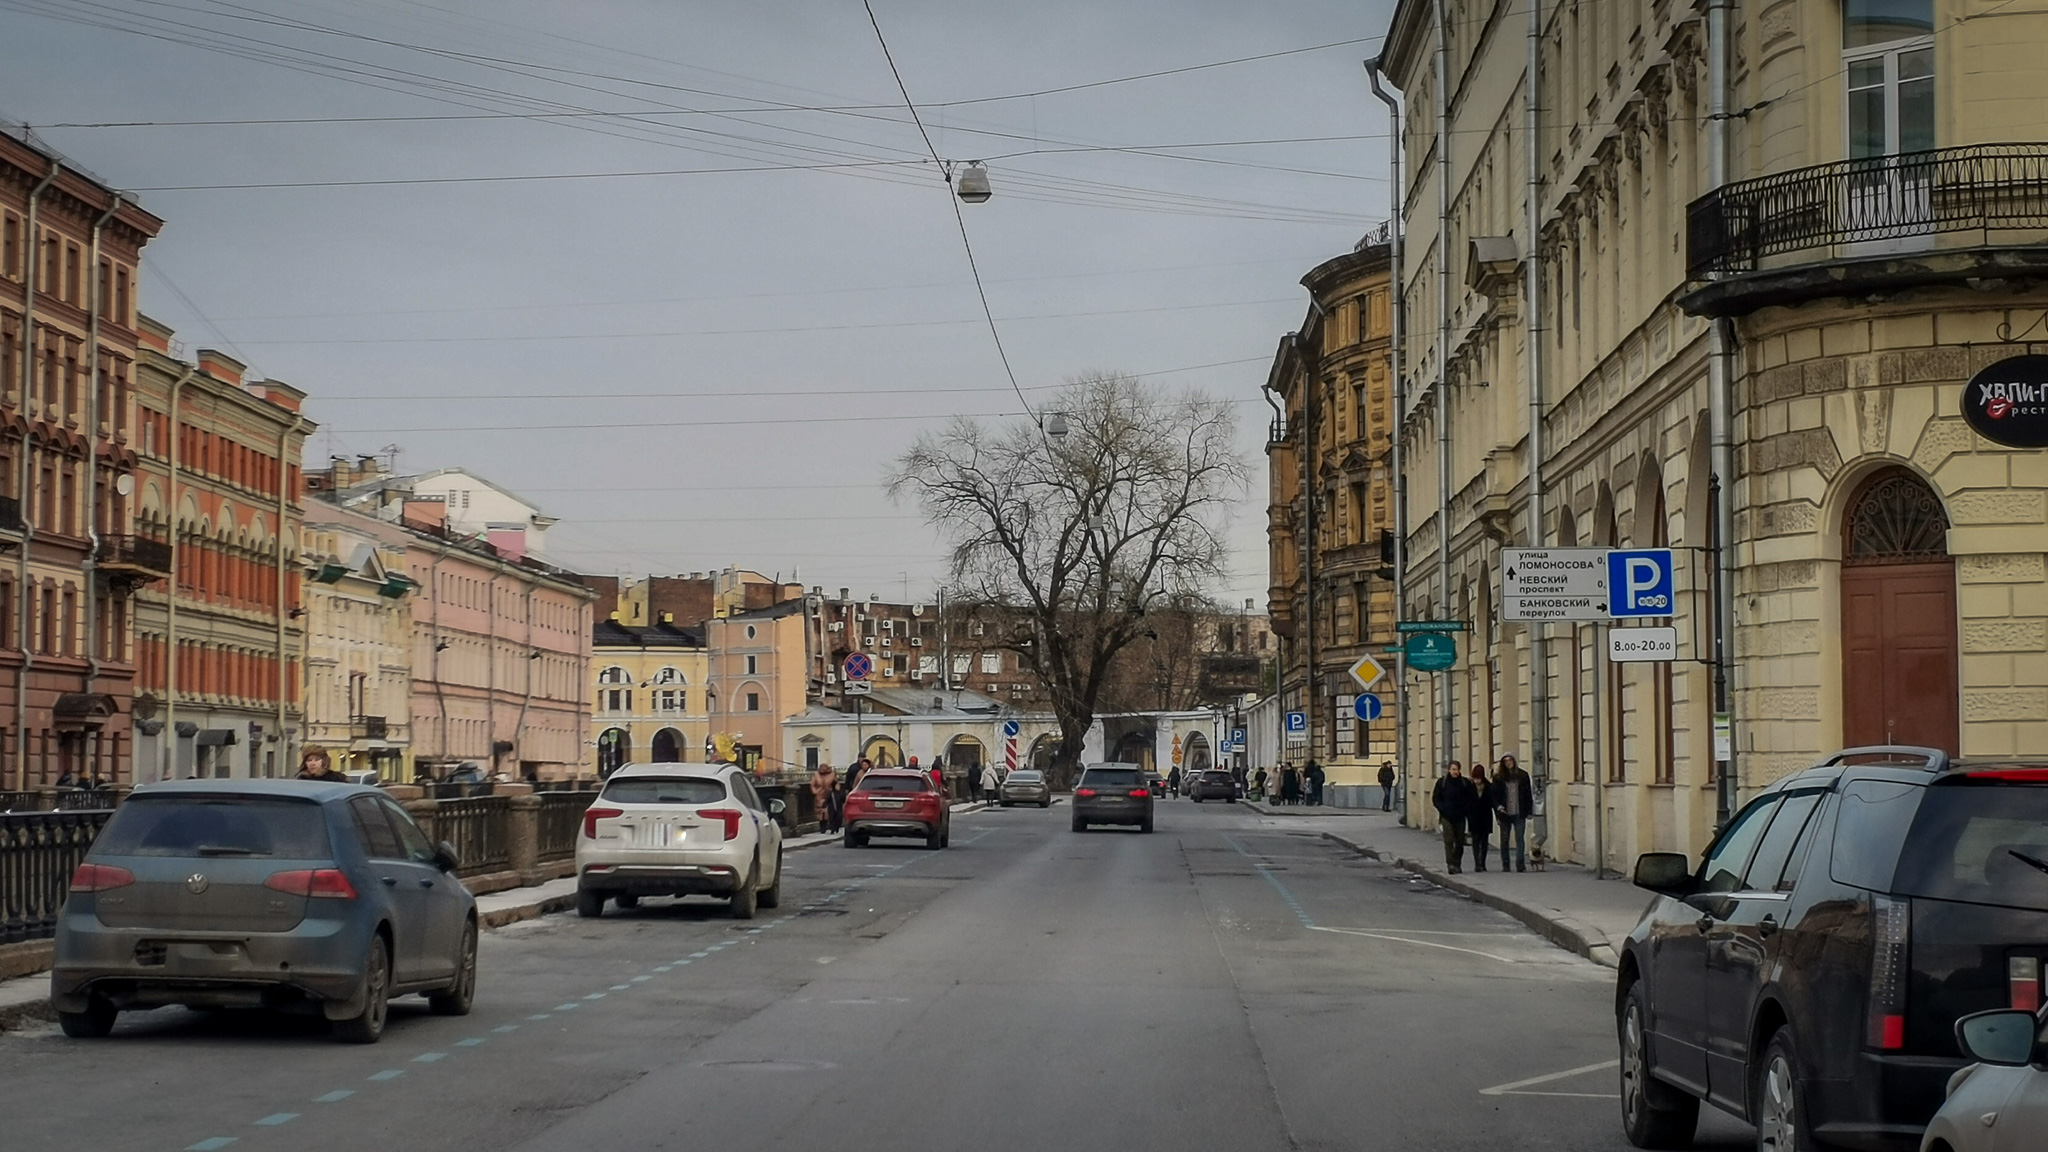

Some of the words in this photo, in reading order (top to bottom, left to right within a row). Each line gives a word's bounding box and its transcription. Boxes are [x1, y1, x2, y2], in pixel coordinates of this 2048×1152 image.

[2011, 407, 2046, 417] рест
[1519, 552, 1549, 560] улица
[1519, 561, 1594, 570] ЛОМОНОСОВА
[1519, 574, 1568, 584] НЕВСКИЙ
[1519, 586, 1565, 595] проспект
[1520, 598, 1590, 608] БАНКОВСКИЙ
[1656, 596, 1666, 606] 20
[1520, 610, 1567, 618] переулок
[1614, 640, 1671, 651] 8.00-20.00
